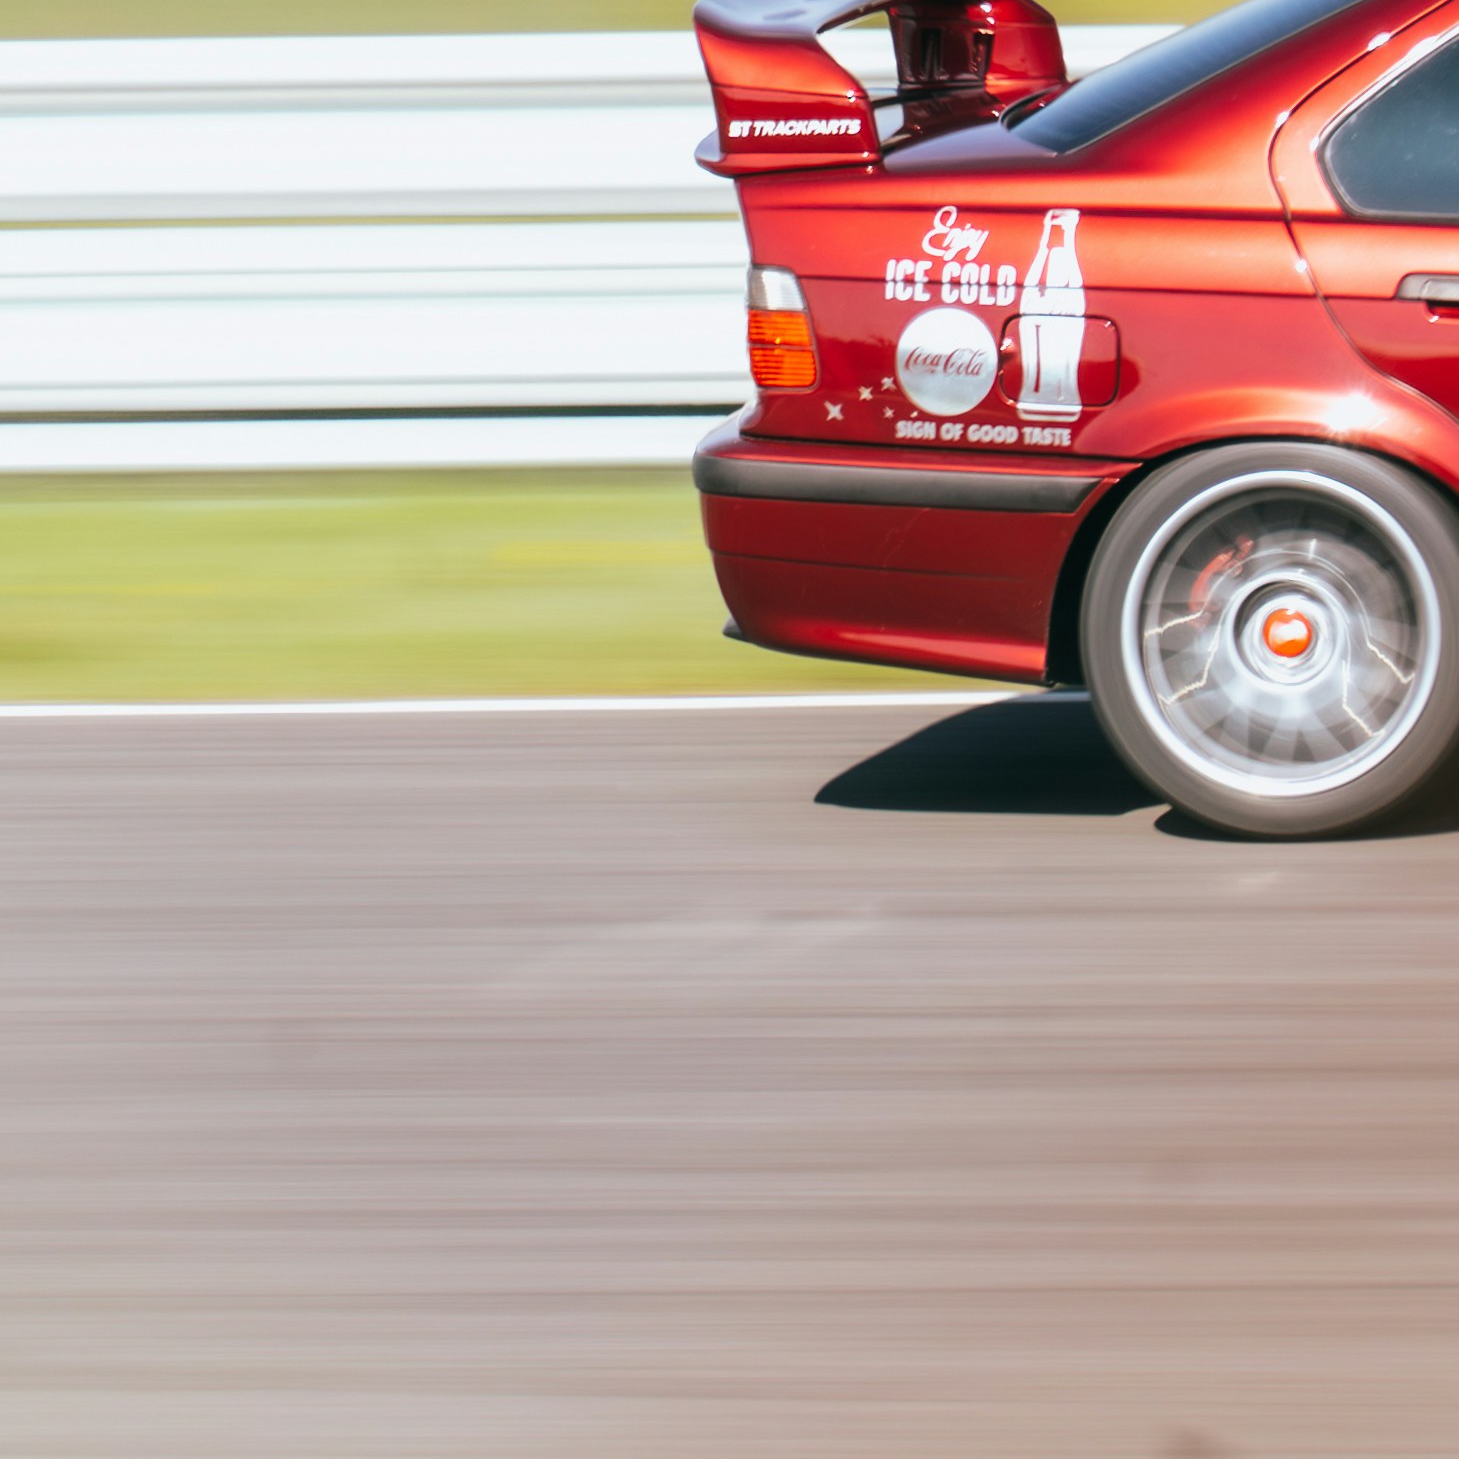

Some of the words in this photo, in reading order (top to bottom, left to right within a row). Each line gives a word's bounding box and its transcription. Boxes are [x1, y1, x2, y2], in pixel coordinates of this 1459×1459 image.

[753, 118, 862, 137] TRACKPARTS
[885, 259, 933, 302] ICE
[941, 261, 1017, 307] COLD
[895, 420, 937, 440] SIGN
[940, 422, 965, 441] OF
[966, 423, 1019, 443] GOOD
[1021, 426, 1072, 447] TASTE
